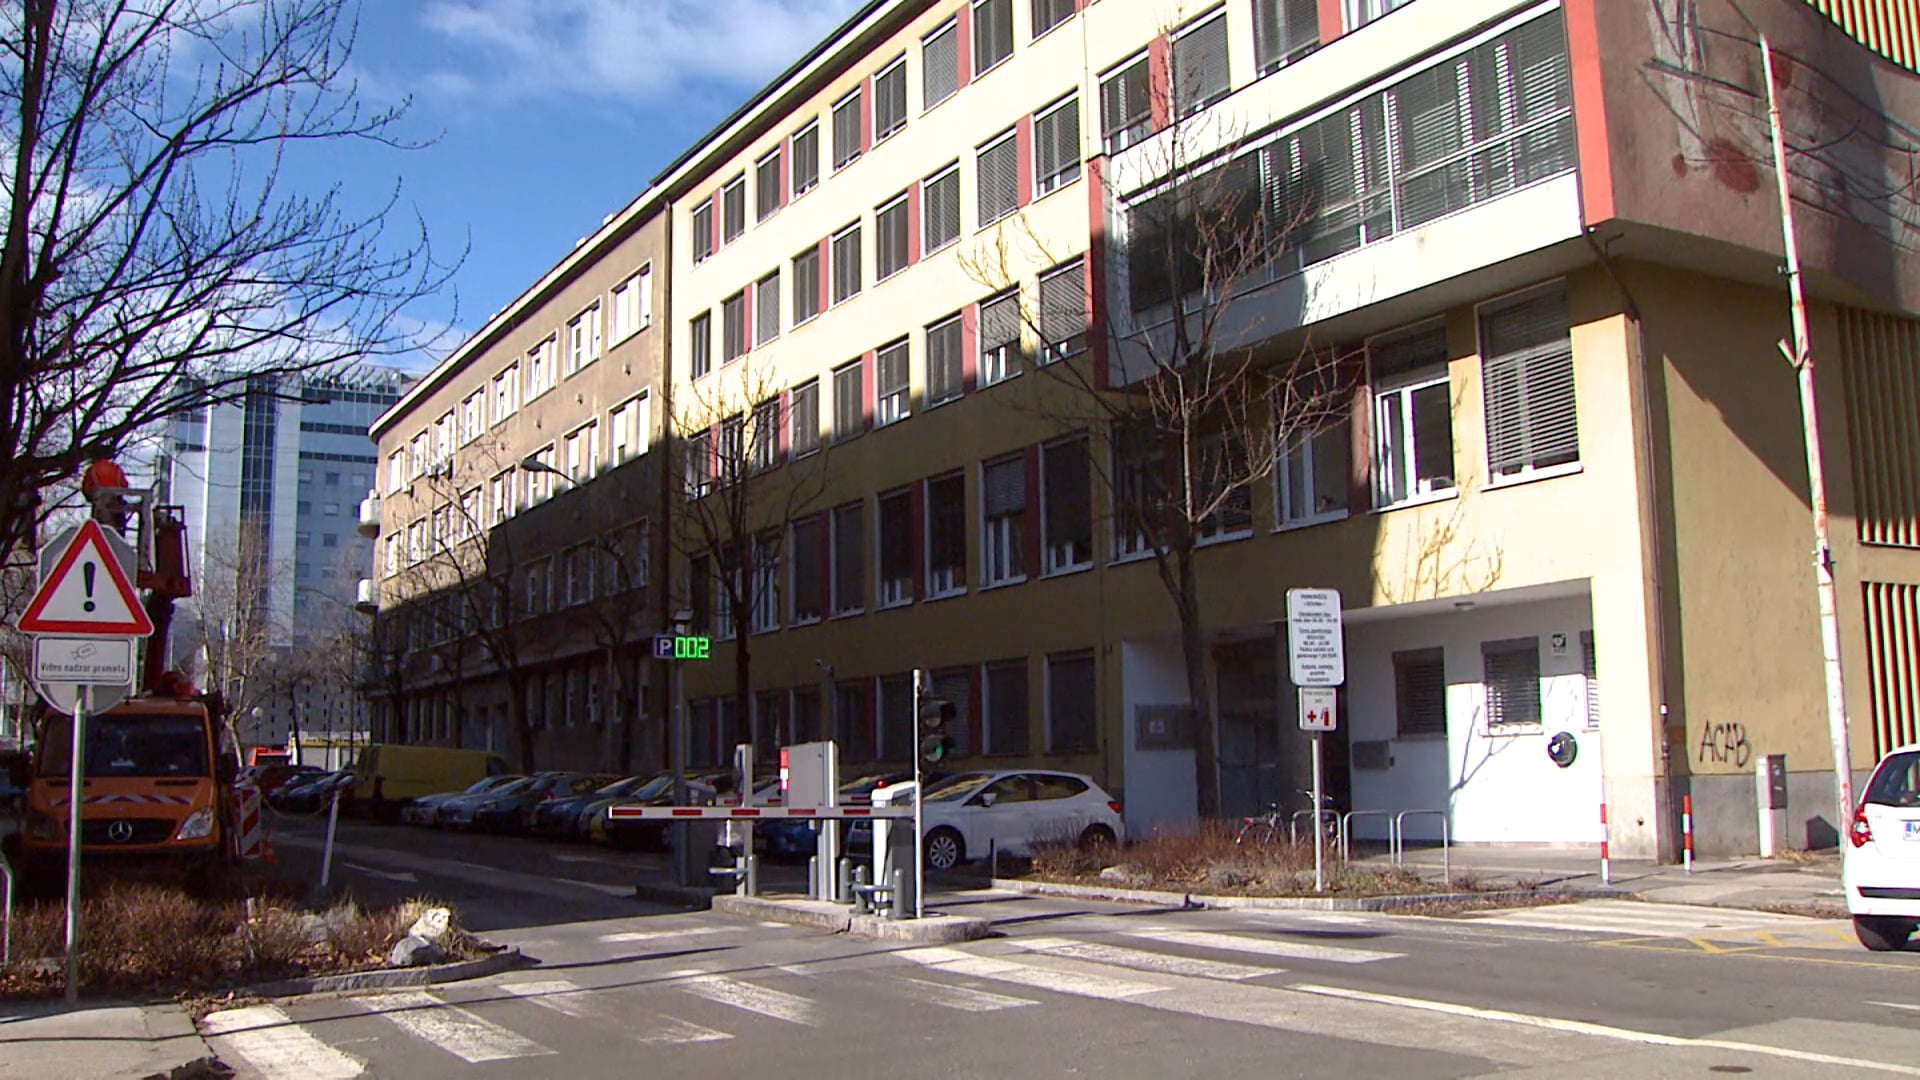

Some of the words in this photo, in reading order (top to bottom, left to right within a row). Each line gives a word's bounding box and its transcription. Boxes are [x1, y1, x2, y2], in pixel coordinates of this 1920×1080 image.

[660, 638, 673, 657] P
[675, 636, 709, 658] 002
[1699, 719, 1752, 768] ACAB
